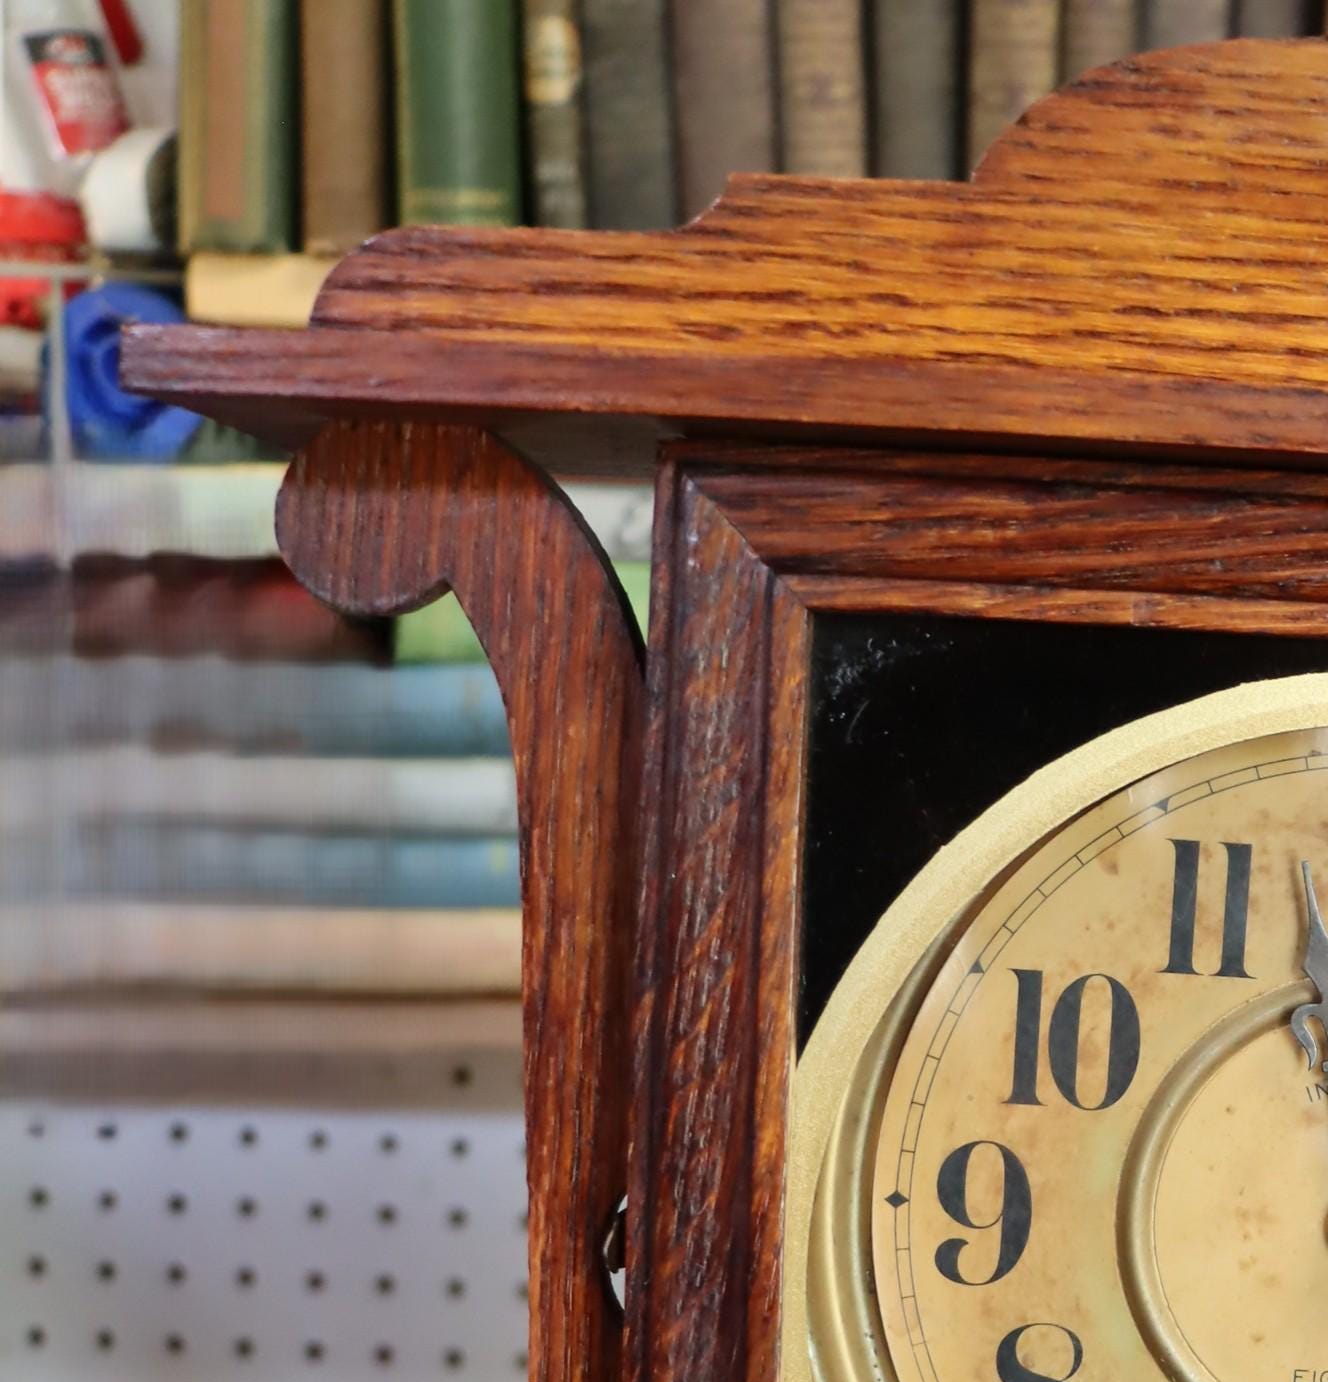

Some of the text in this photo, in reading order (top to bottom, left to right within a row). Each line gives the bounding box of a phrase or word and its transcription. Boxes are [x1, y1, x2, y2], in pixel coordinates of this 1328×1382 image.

[1155, 838, 1258, 979] 11
[999, 967, 1141, 1111] 10
[934, 1140, 1032, 1286] 9
